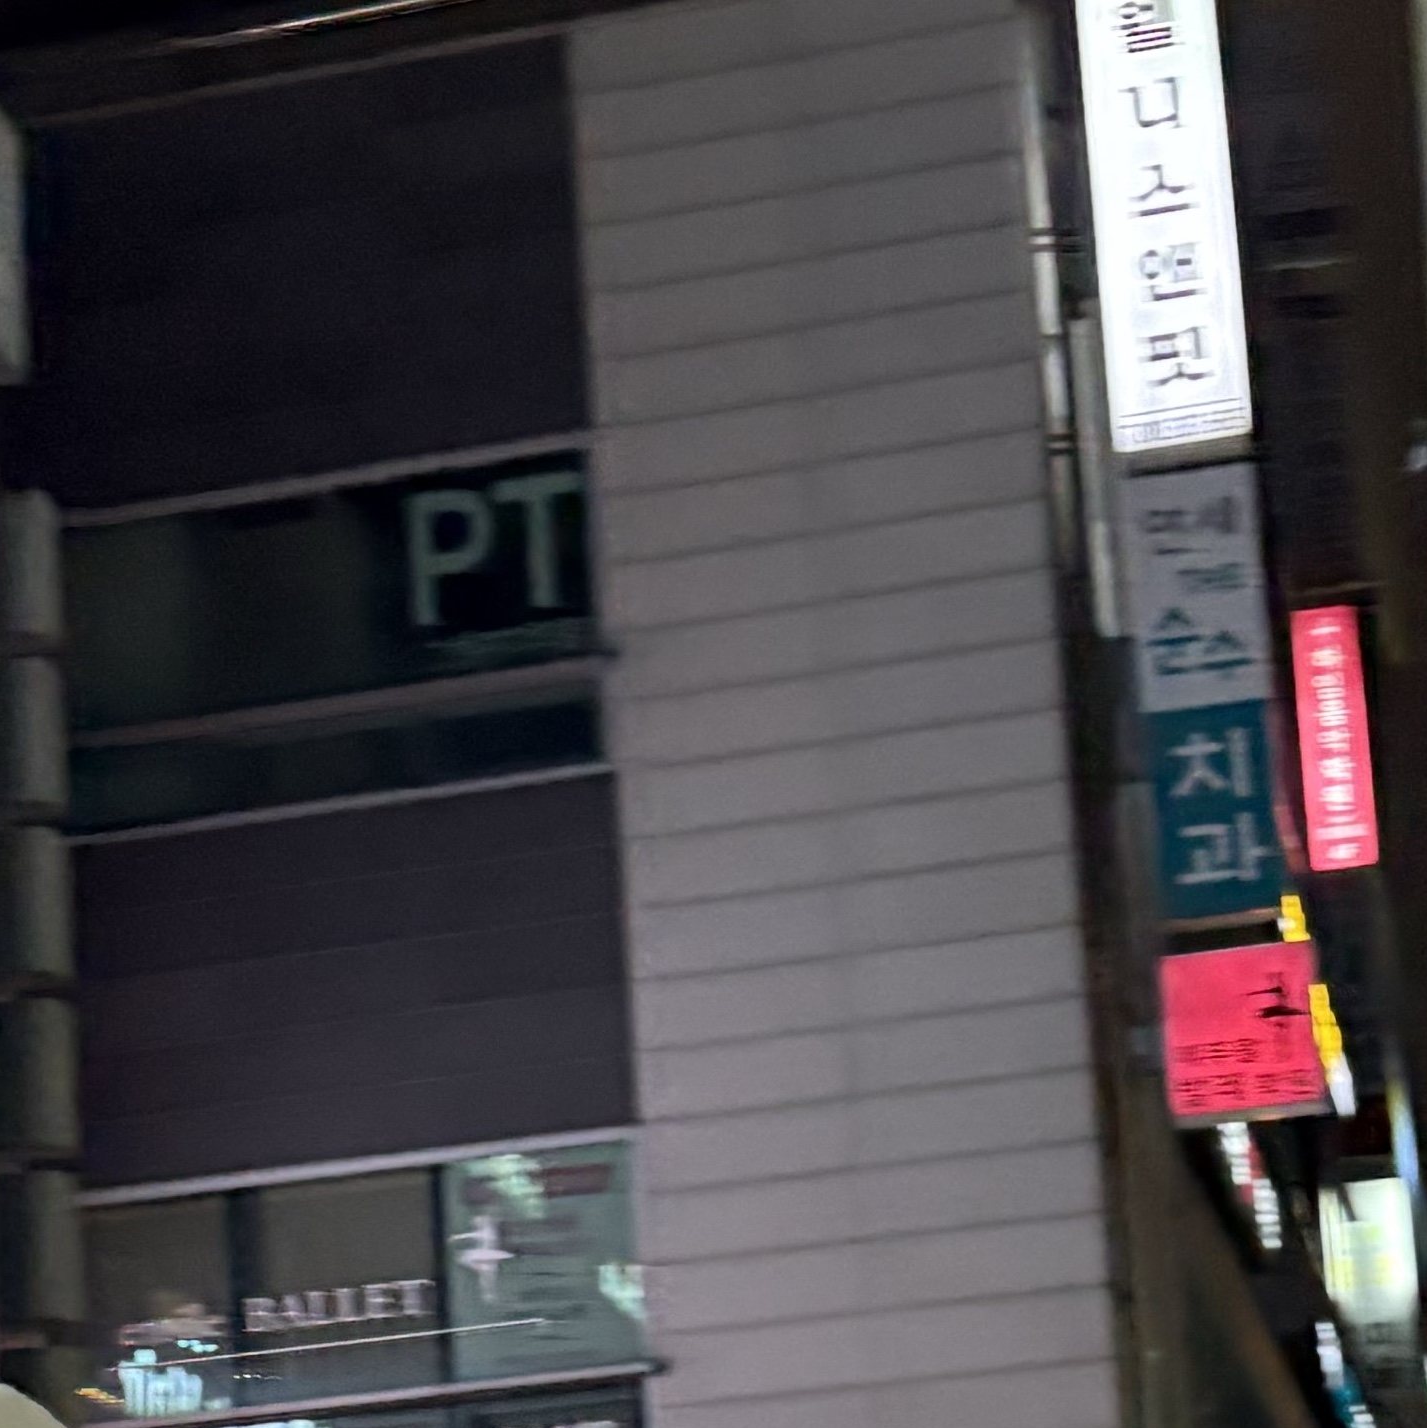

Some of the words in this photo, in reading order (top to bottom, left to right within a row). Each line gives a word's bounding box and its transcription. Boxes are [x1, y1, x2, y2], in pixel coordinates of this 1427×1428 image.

[402, 470, 587, 627] PT
[1166, 725, 1267, 884] 치과
[240, 1278, 438, 1333] BALLET
